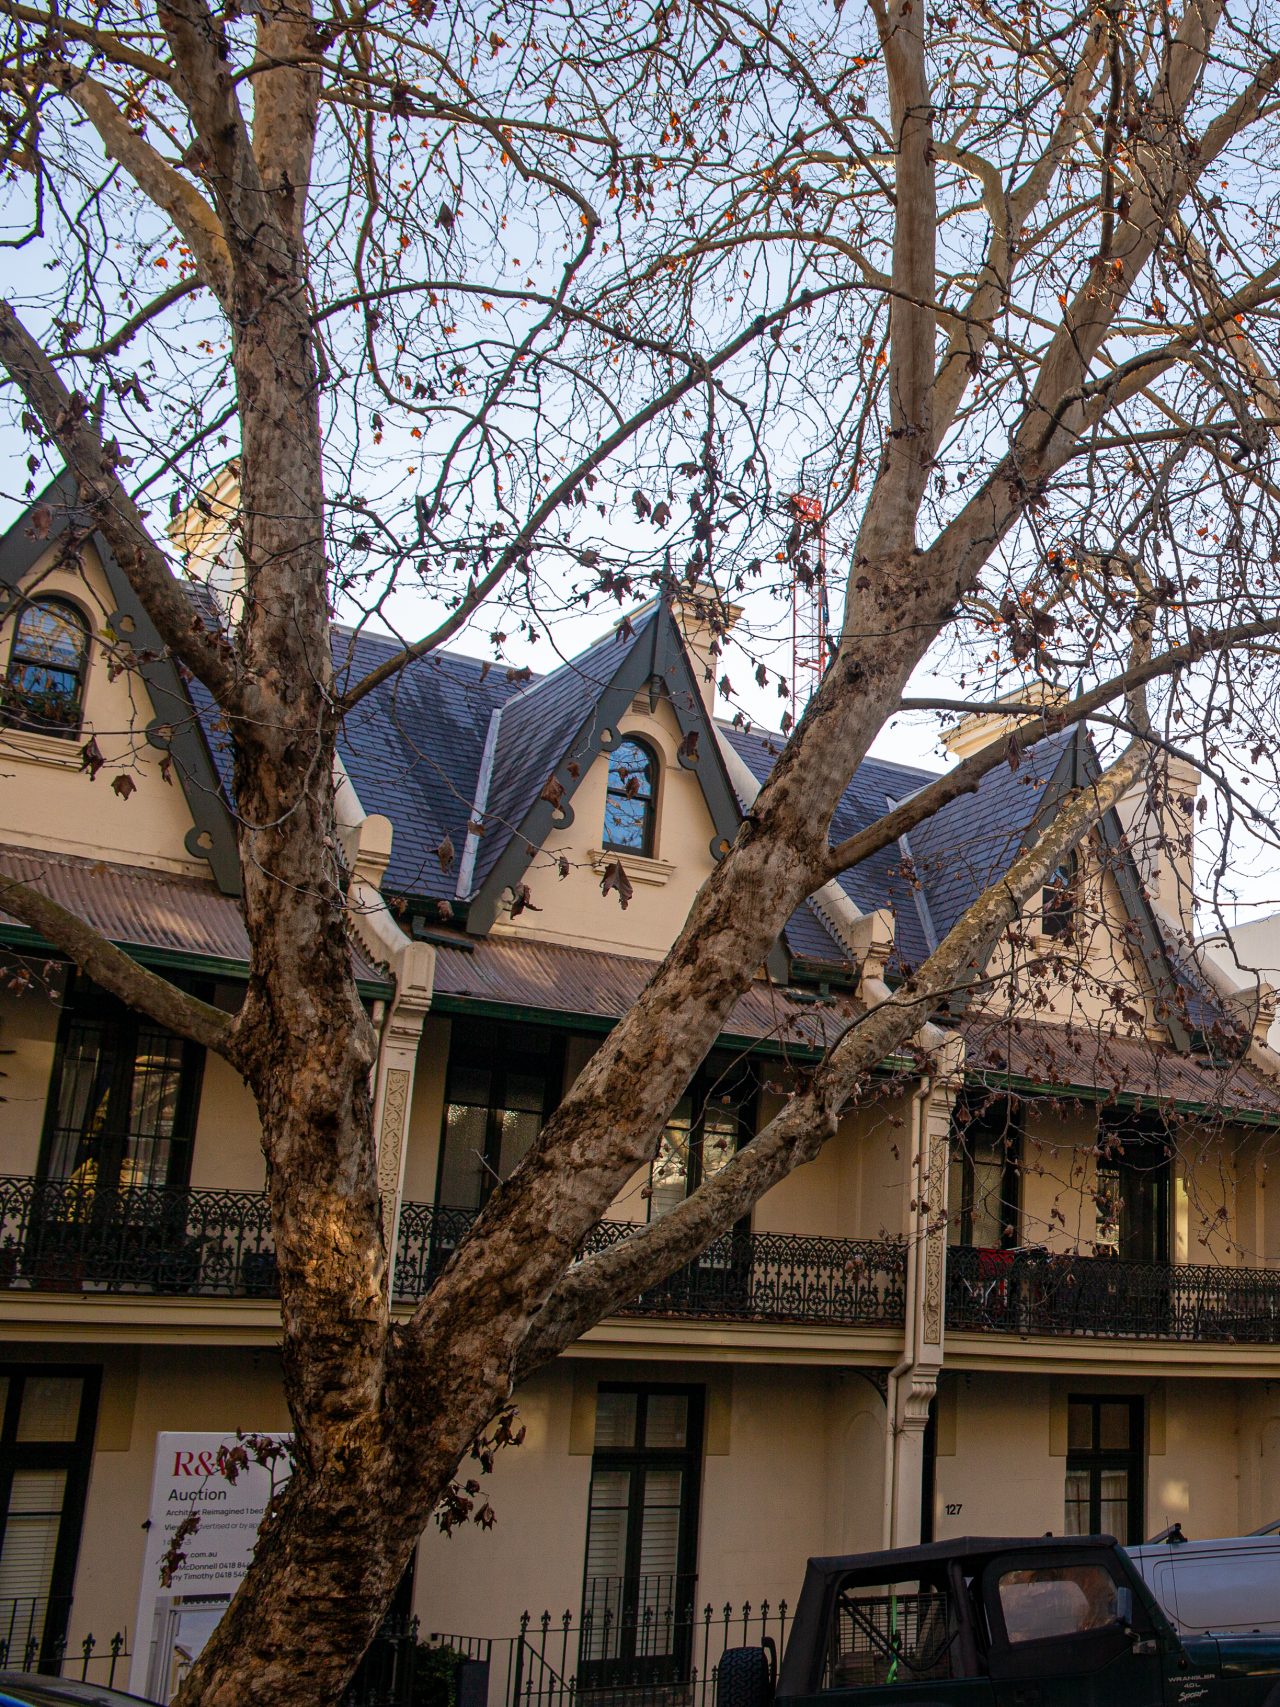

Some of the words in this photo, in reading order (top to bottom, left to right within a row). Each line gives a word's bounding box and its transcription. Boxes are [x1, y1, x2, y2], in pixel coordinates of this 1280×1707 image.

[171, 1451, 230, 1476] R&
[167, 1488, 228, 1502] Auction
[166, 1508, 201, 1517] Architt
[202, 1507, 245, 1517] Reimagined
[250, 1507, 264, 1515] bed
[945, 1503, 963, 1516] 127
[179, 1562, 218, 1571] McDonnell
[184, 1572, 213, 1581] Timothy
[214, 1571, 232, 1579] 0418
[1168, 1673, 1216, 1682] WRANGLER
